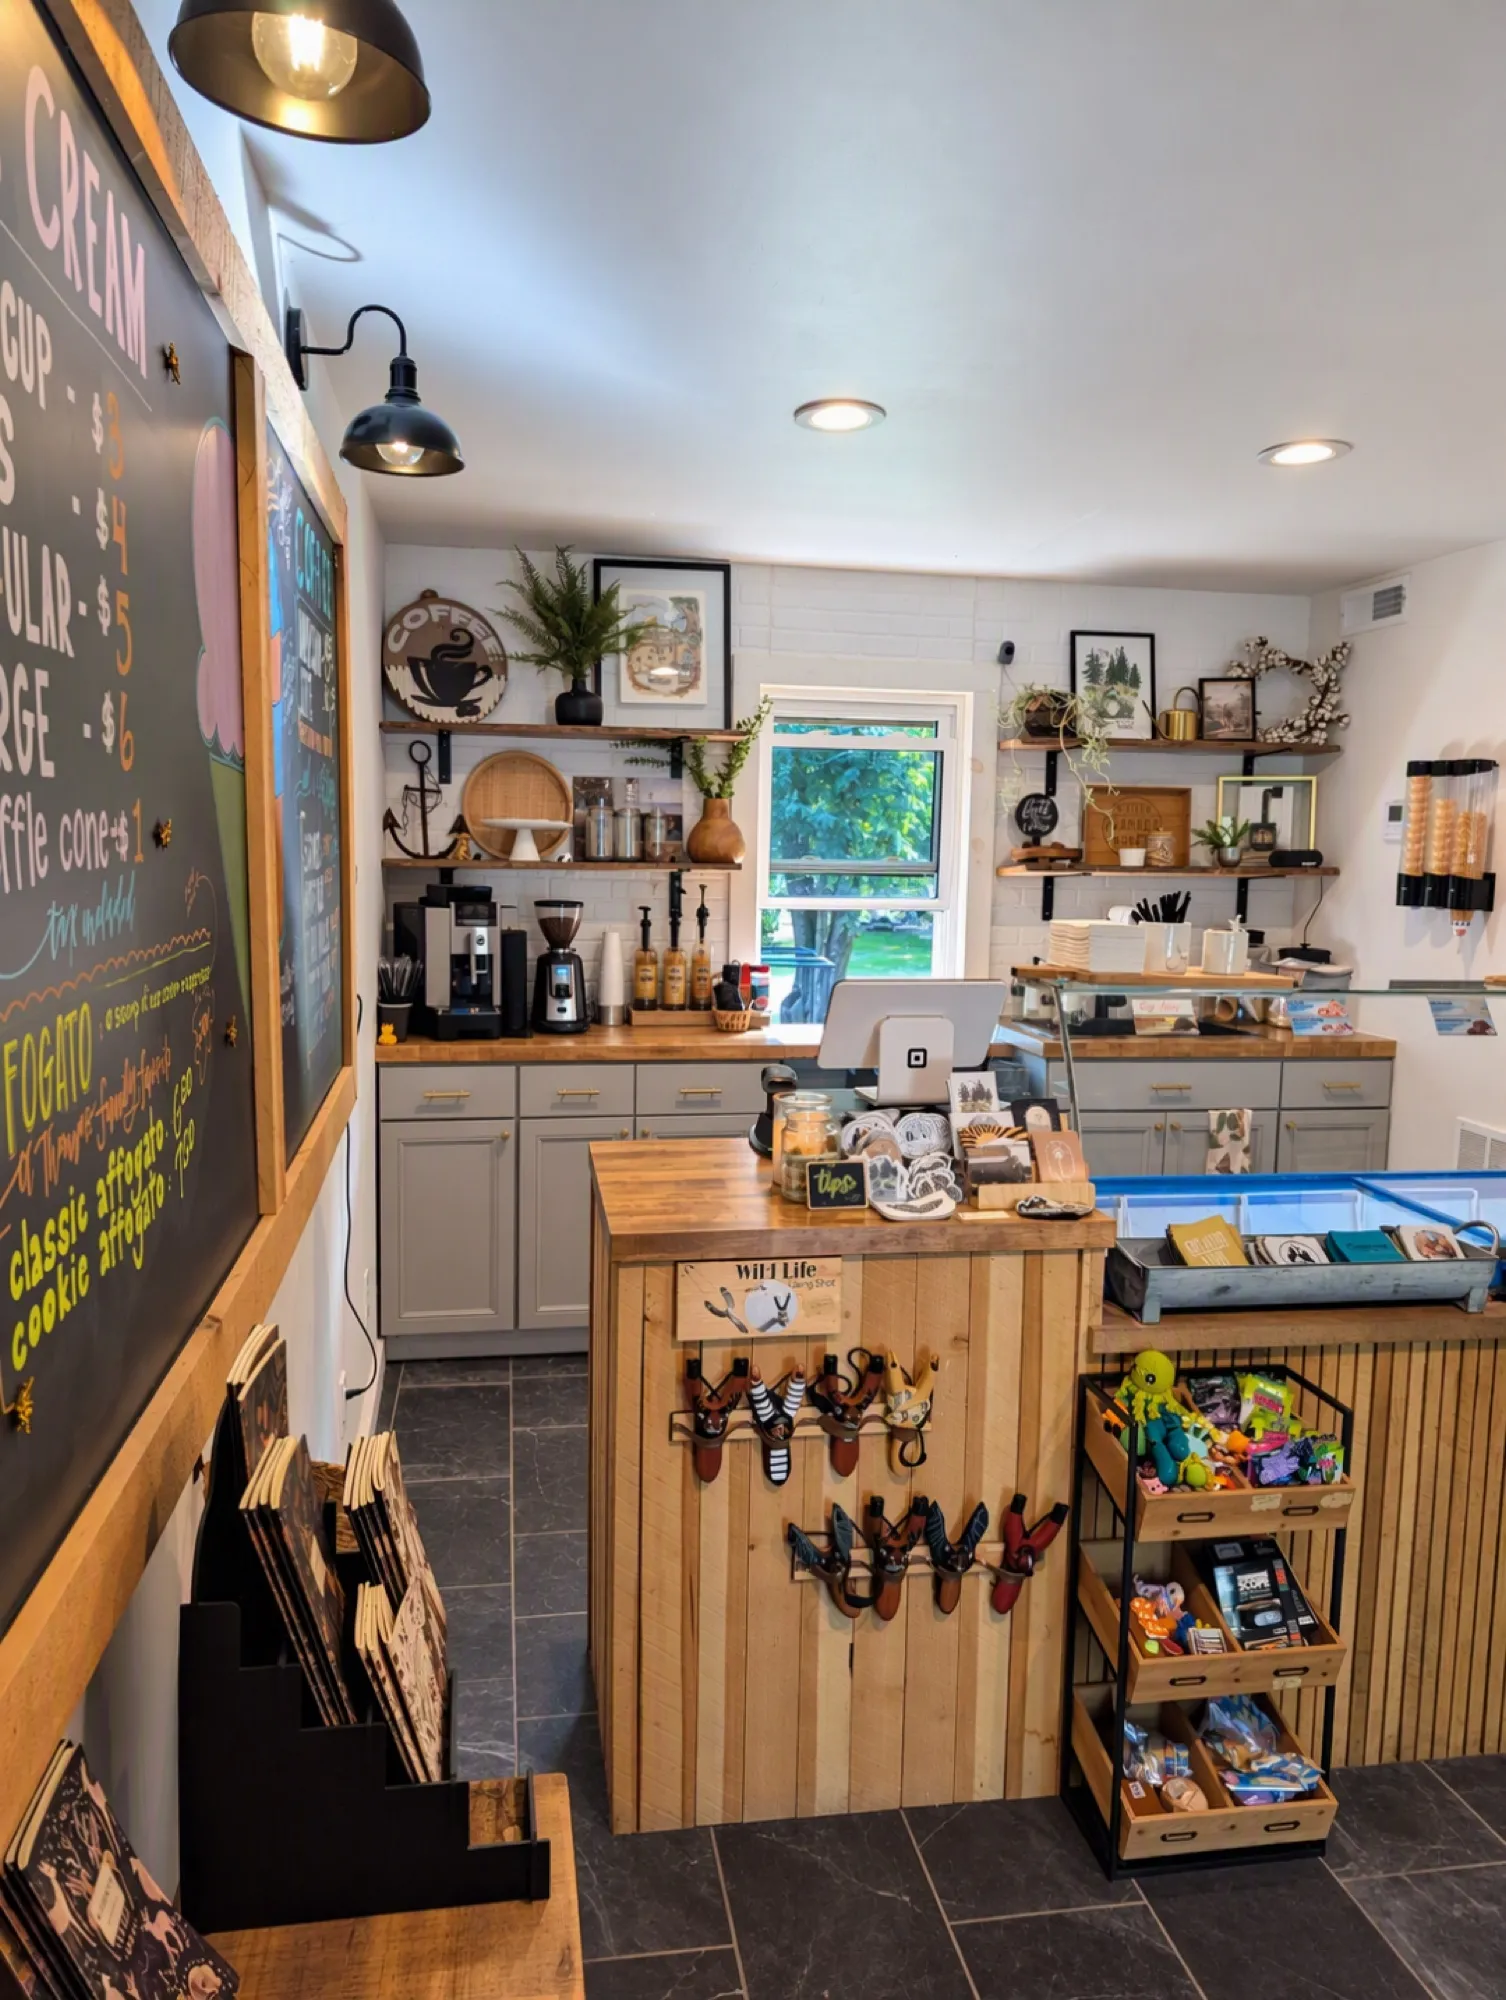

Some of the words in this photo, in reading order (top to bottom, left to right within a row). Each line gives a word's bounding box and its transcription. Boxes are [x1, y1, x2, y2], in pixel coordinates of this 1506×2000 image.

[25, 65, 148, 380] CREAM
[1, 279, 53, 411] CUP
[0, 525, 75, 658] ULAR
[387, 603, 503, 662] COFFEE
[60, 807, 110, 873] cone
[9, 1184, 89, 1302] classic
[783, 1261, 817, 1279] Life
[12, 1252, 90, 1372] cookie
